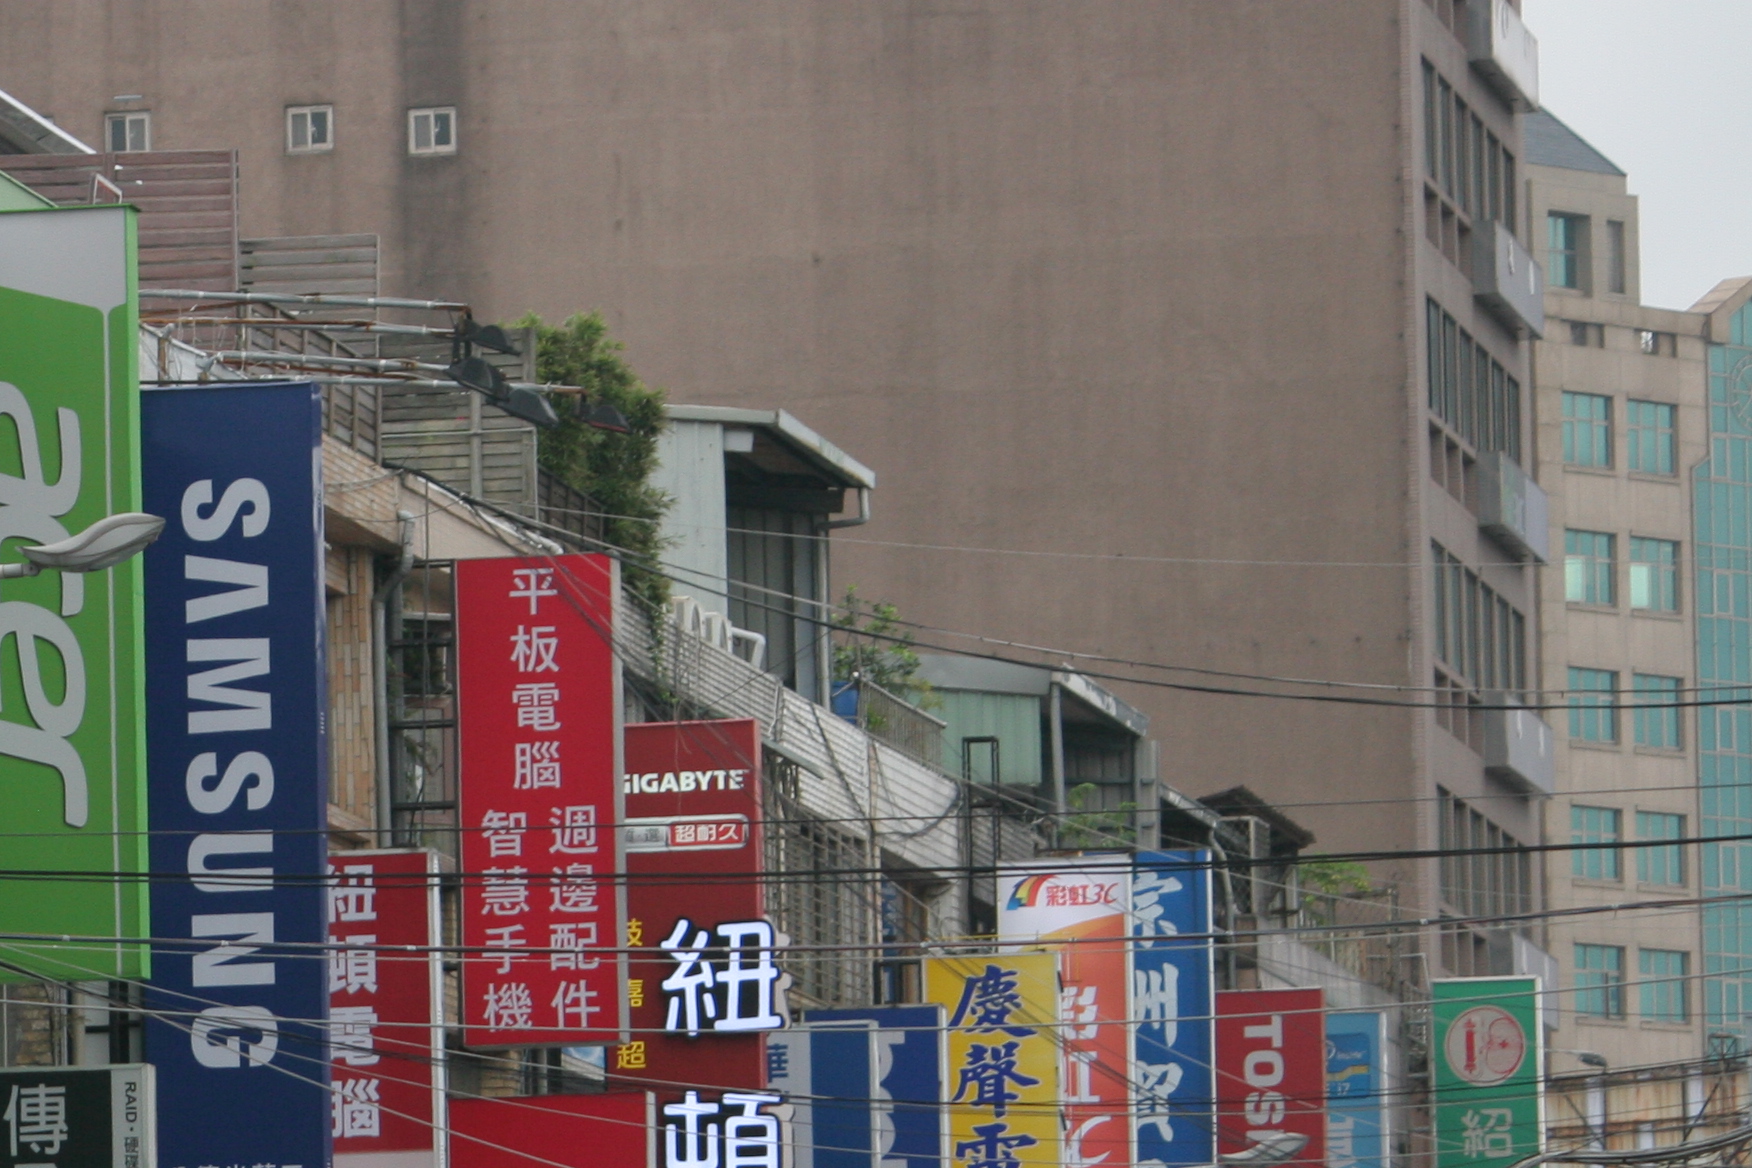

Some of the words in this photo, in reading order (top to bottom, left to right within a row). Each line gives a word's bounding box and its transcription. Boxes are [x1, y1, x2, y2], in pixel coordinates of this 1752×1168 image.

[180, 476, 279, 1070] SAMSUNG
[509, 567, 561, 790] 平板電腦
[481, 809, 534, 1033] 智慧手機
[548, 805, 601, 1031] 週邊配件
[675, 823, 740, 844] 超耐久
[328, 863, 381, 1138] 紐頓電腦
